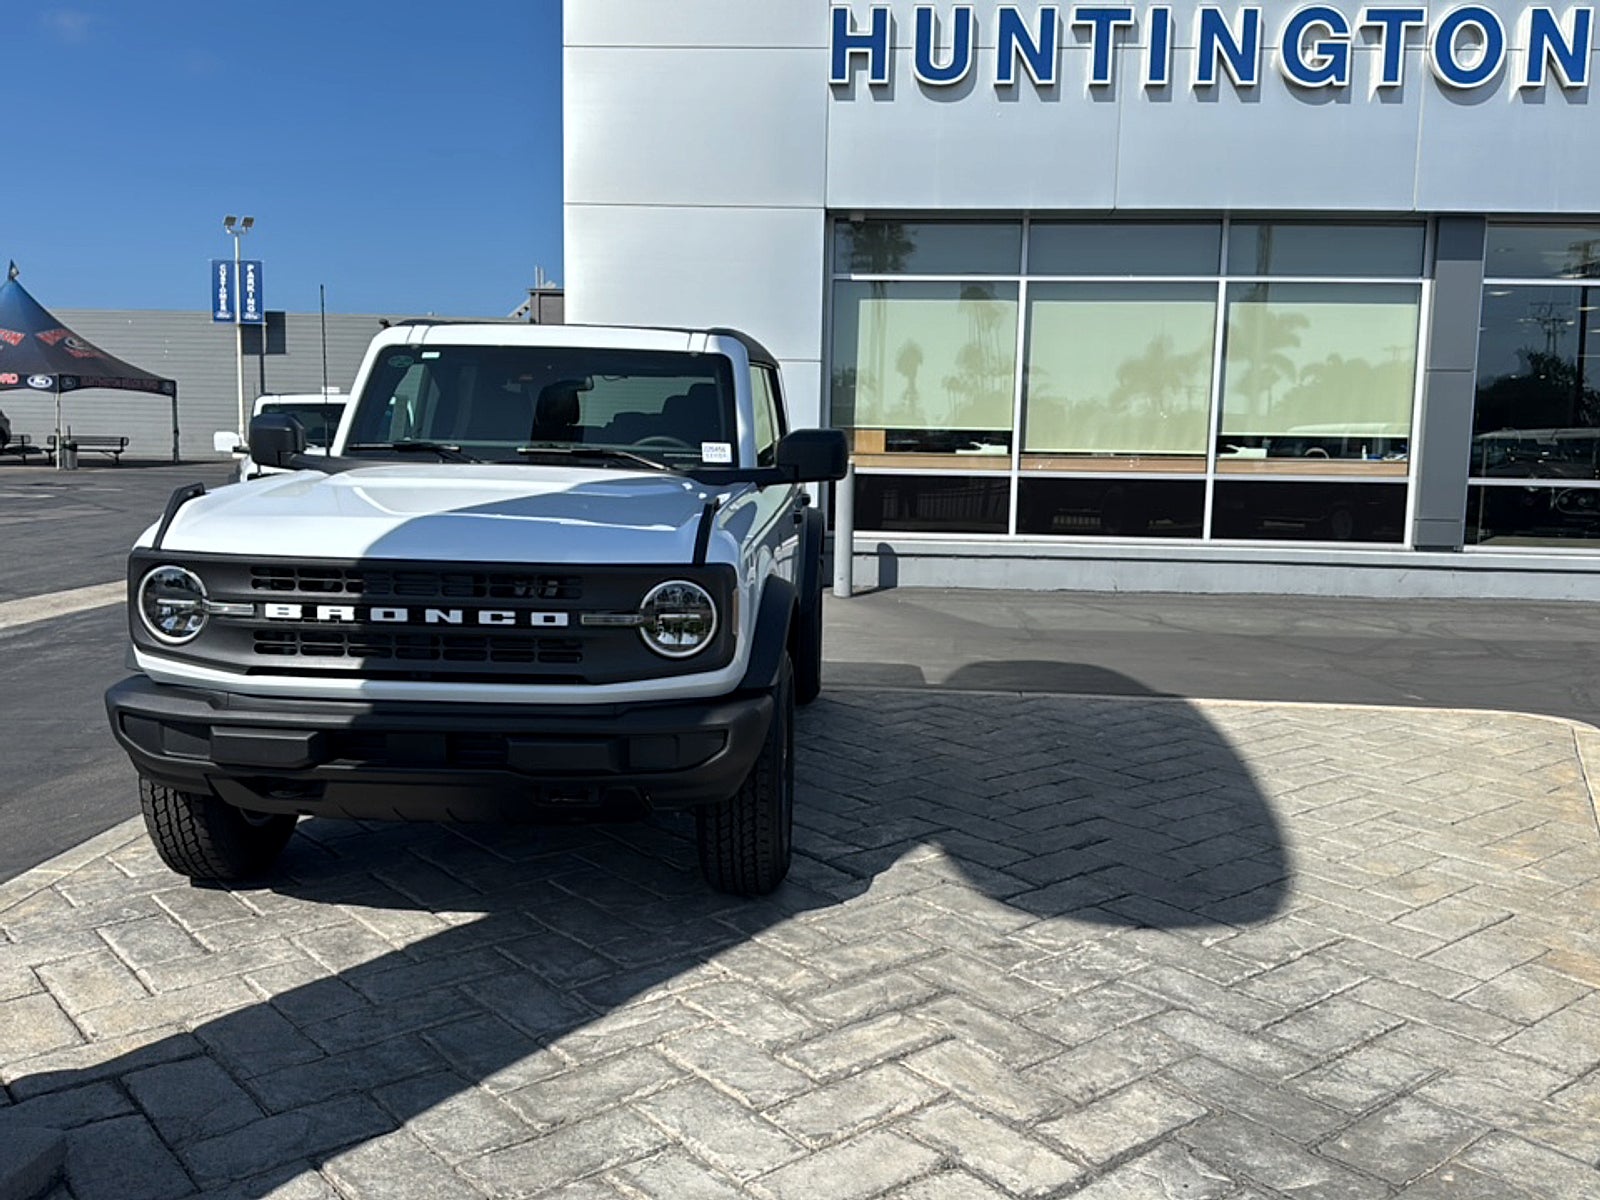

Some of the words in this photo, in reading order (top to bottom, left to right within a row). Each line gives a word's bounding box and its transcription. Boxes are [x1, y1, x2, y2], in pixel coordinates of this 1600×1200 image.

[828, 4, 1594, 90] HUNTINGTON
[219, 263, 227, 311] CUSTOMER
[246, 264, 255, 312] PARKING
[264, 603, 569, 626] BRONCO
